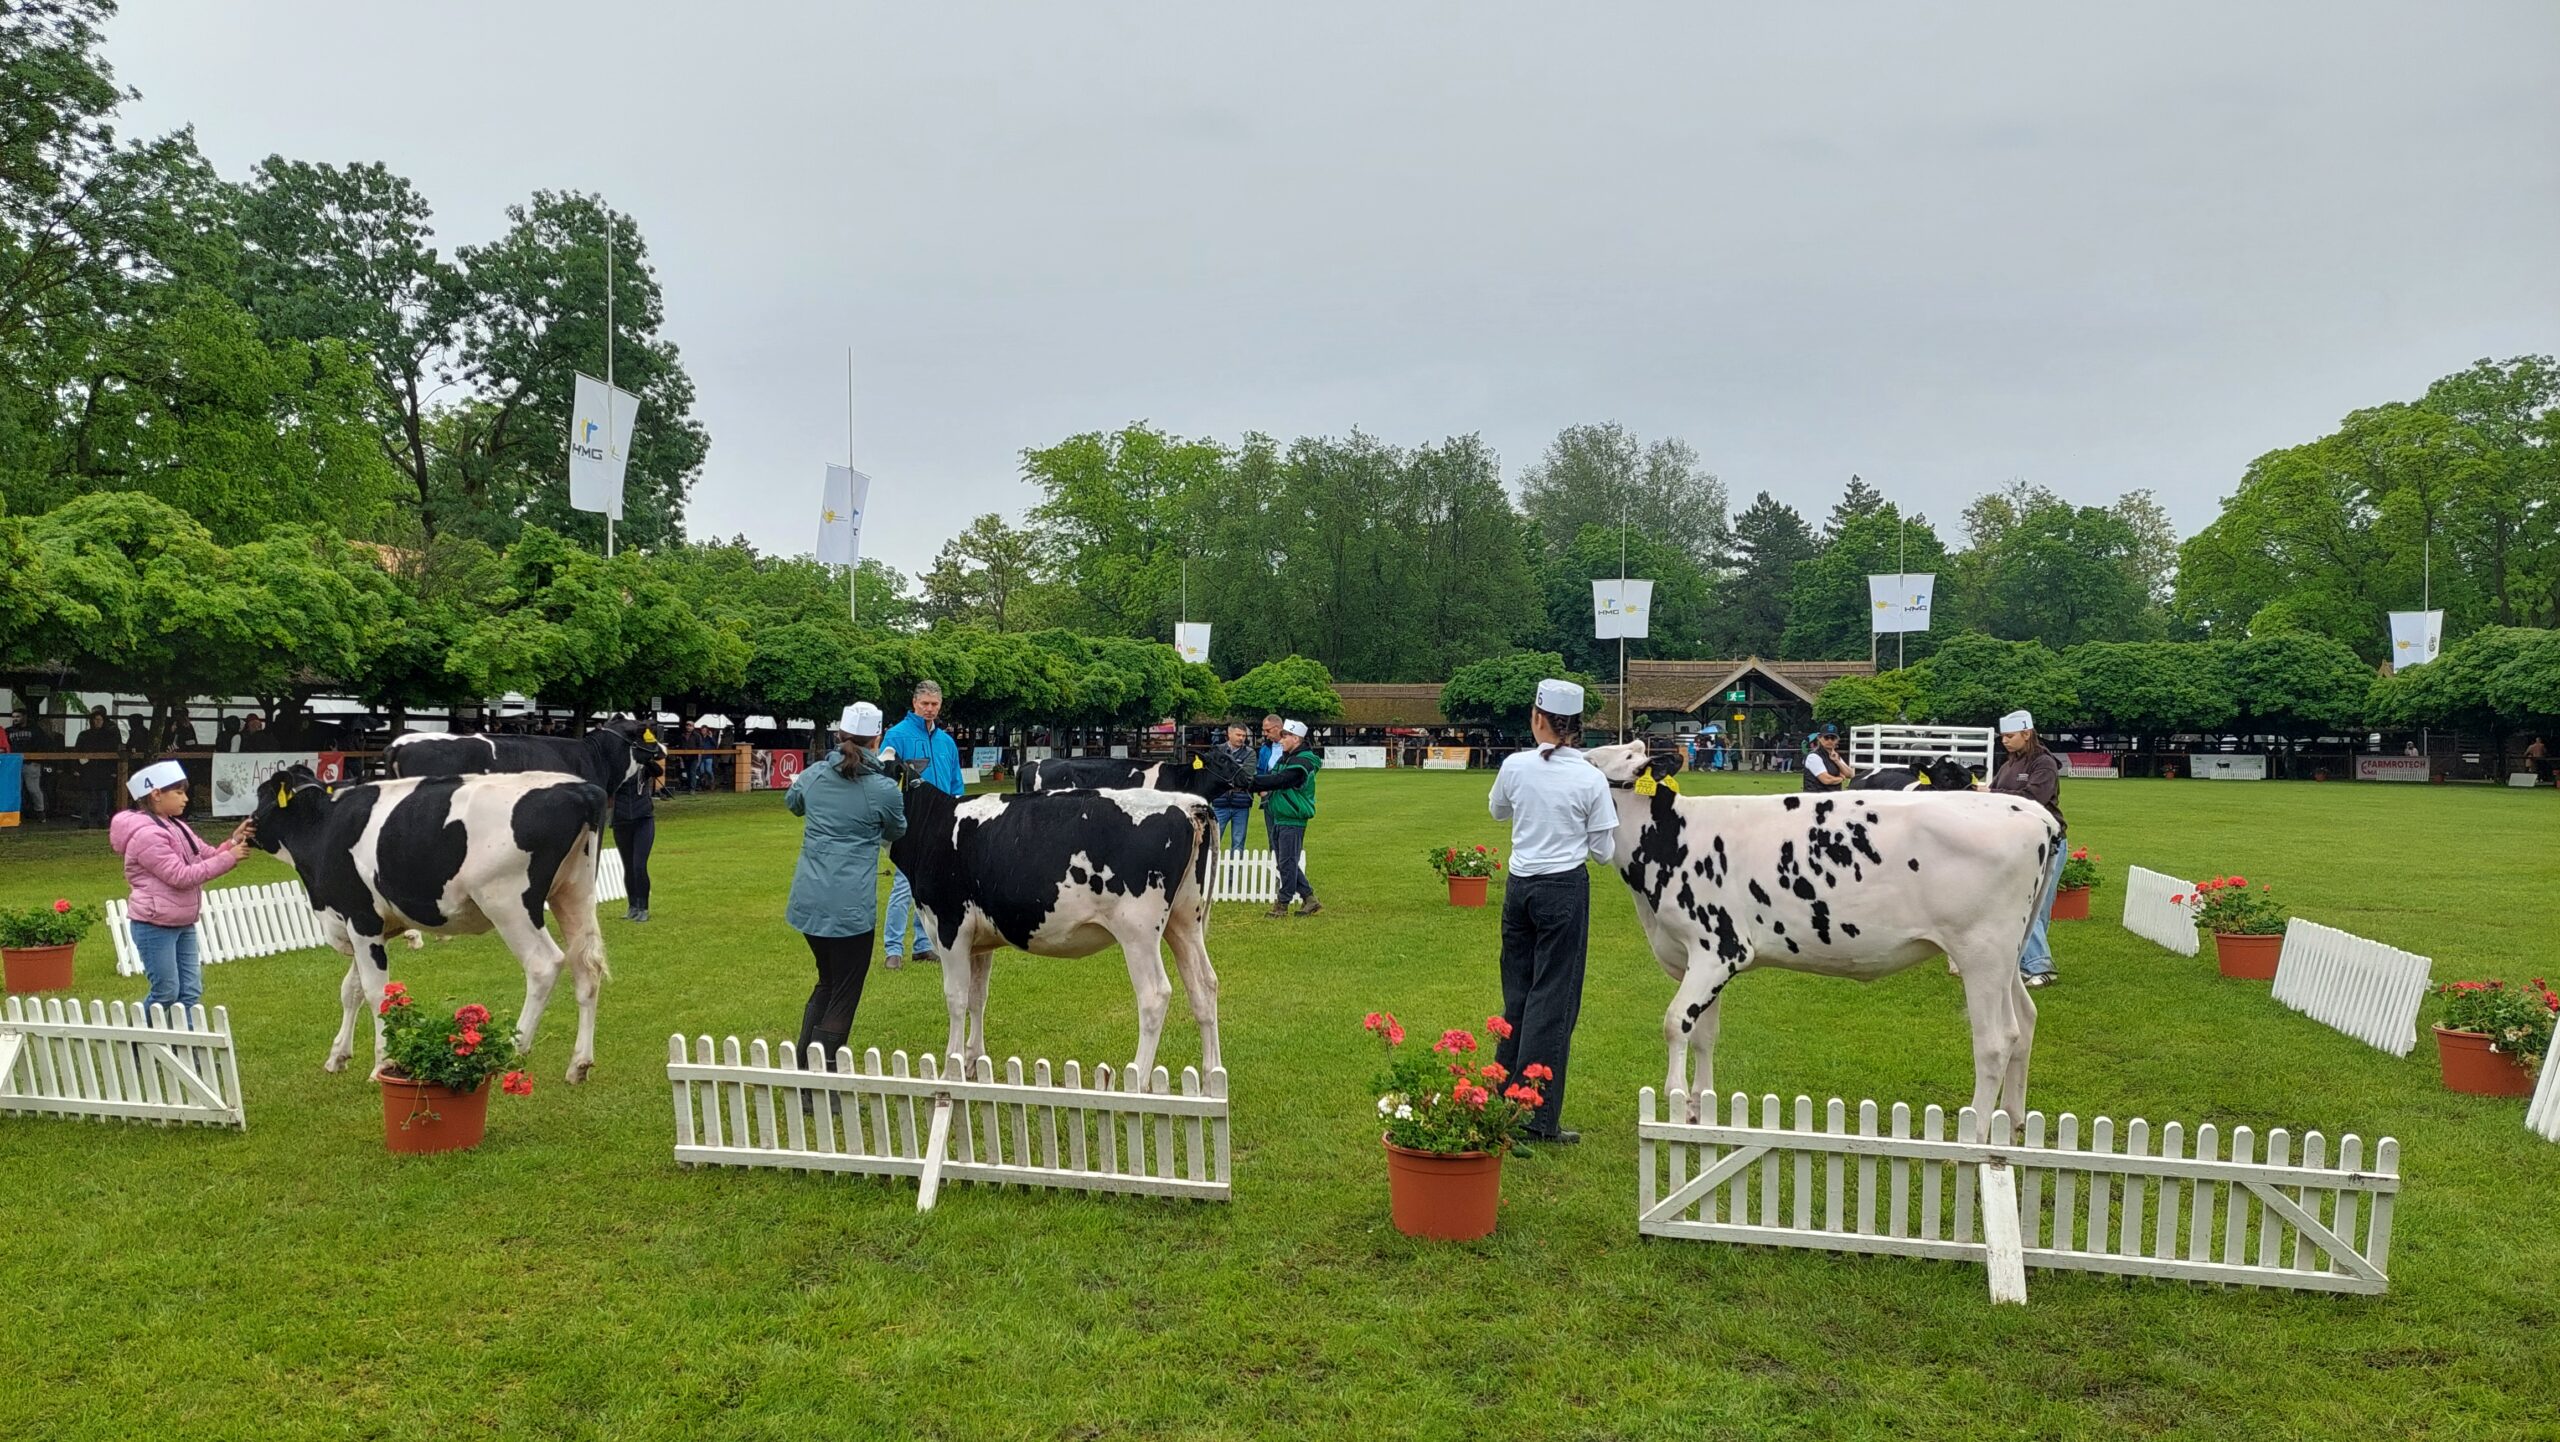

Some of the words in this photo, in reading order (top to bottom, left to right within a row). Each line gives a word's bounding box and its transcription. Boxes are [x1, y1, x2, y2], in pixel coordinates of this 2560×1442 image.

[572, 443, 603, 461] HMG
[1538, 692, 1543, 706] 6
[2022, 720, 2028, 730] 1
[144, 777, 154, 789] 4
